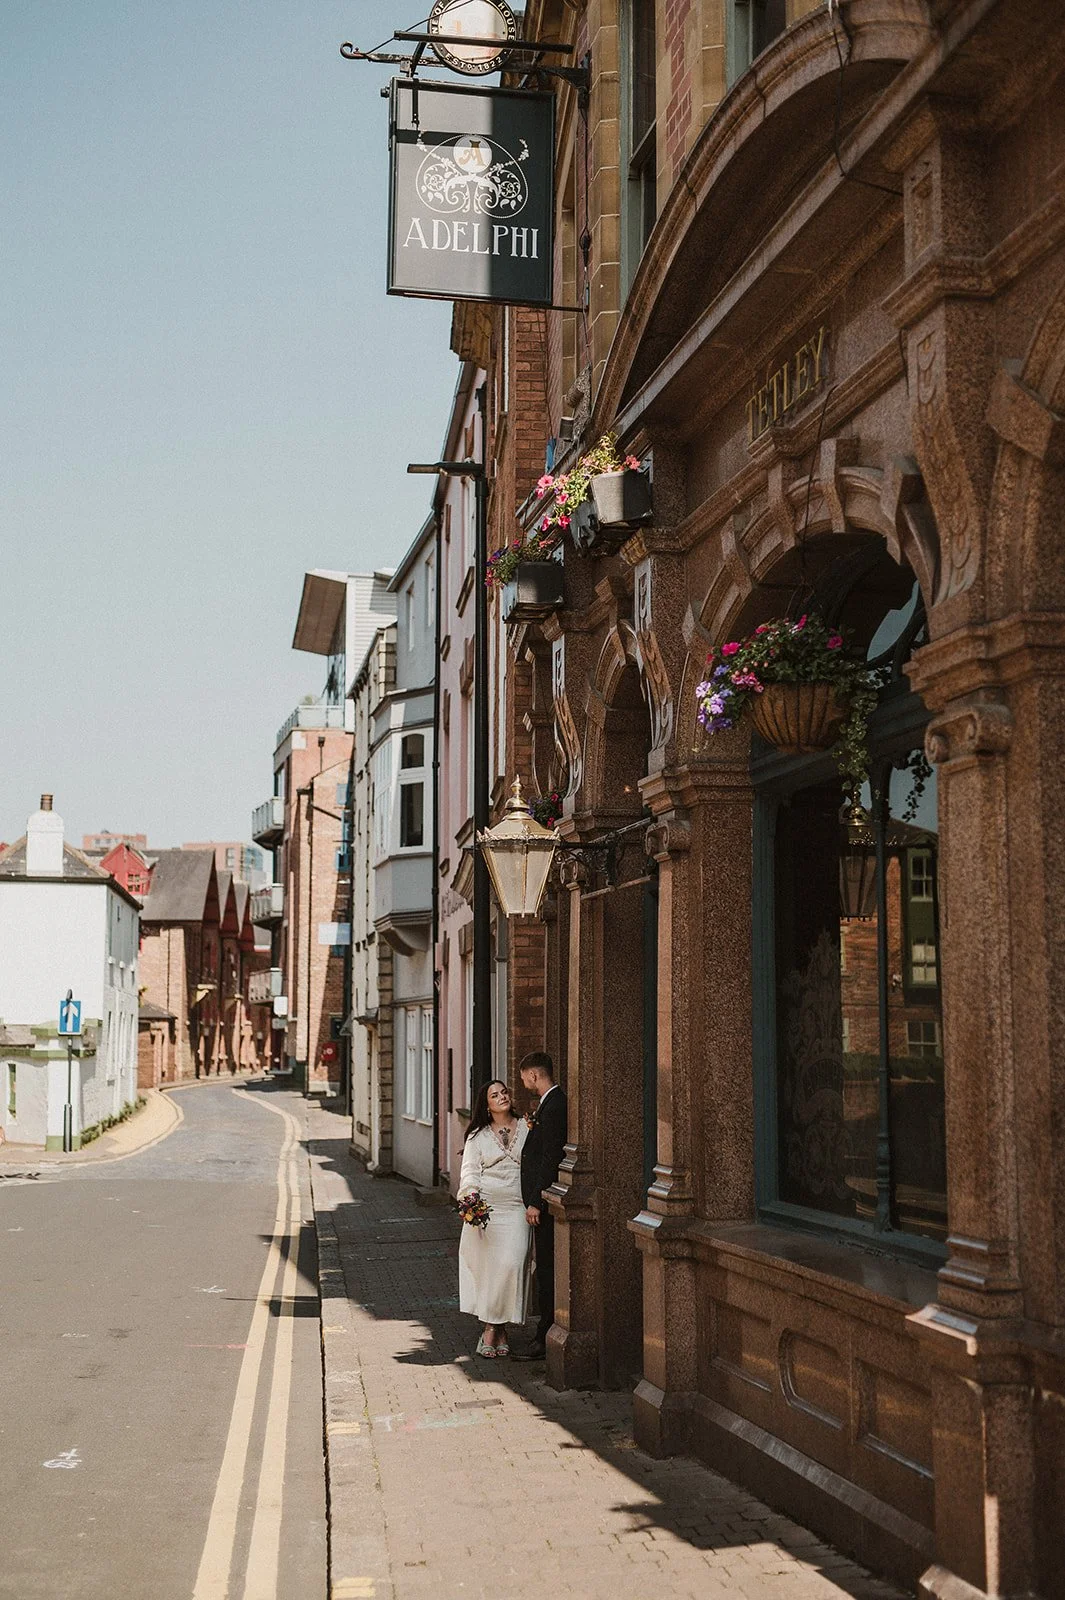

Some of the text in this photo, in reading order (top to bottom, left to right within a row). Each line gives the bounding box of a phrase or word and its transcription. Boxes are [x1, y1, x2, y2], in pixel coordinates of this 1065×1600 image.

[477, 56, 503, 71] 1822
[402, 217, 539, 259] ADELPHI
[745, 325, 825, 442] TETLEY
